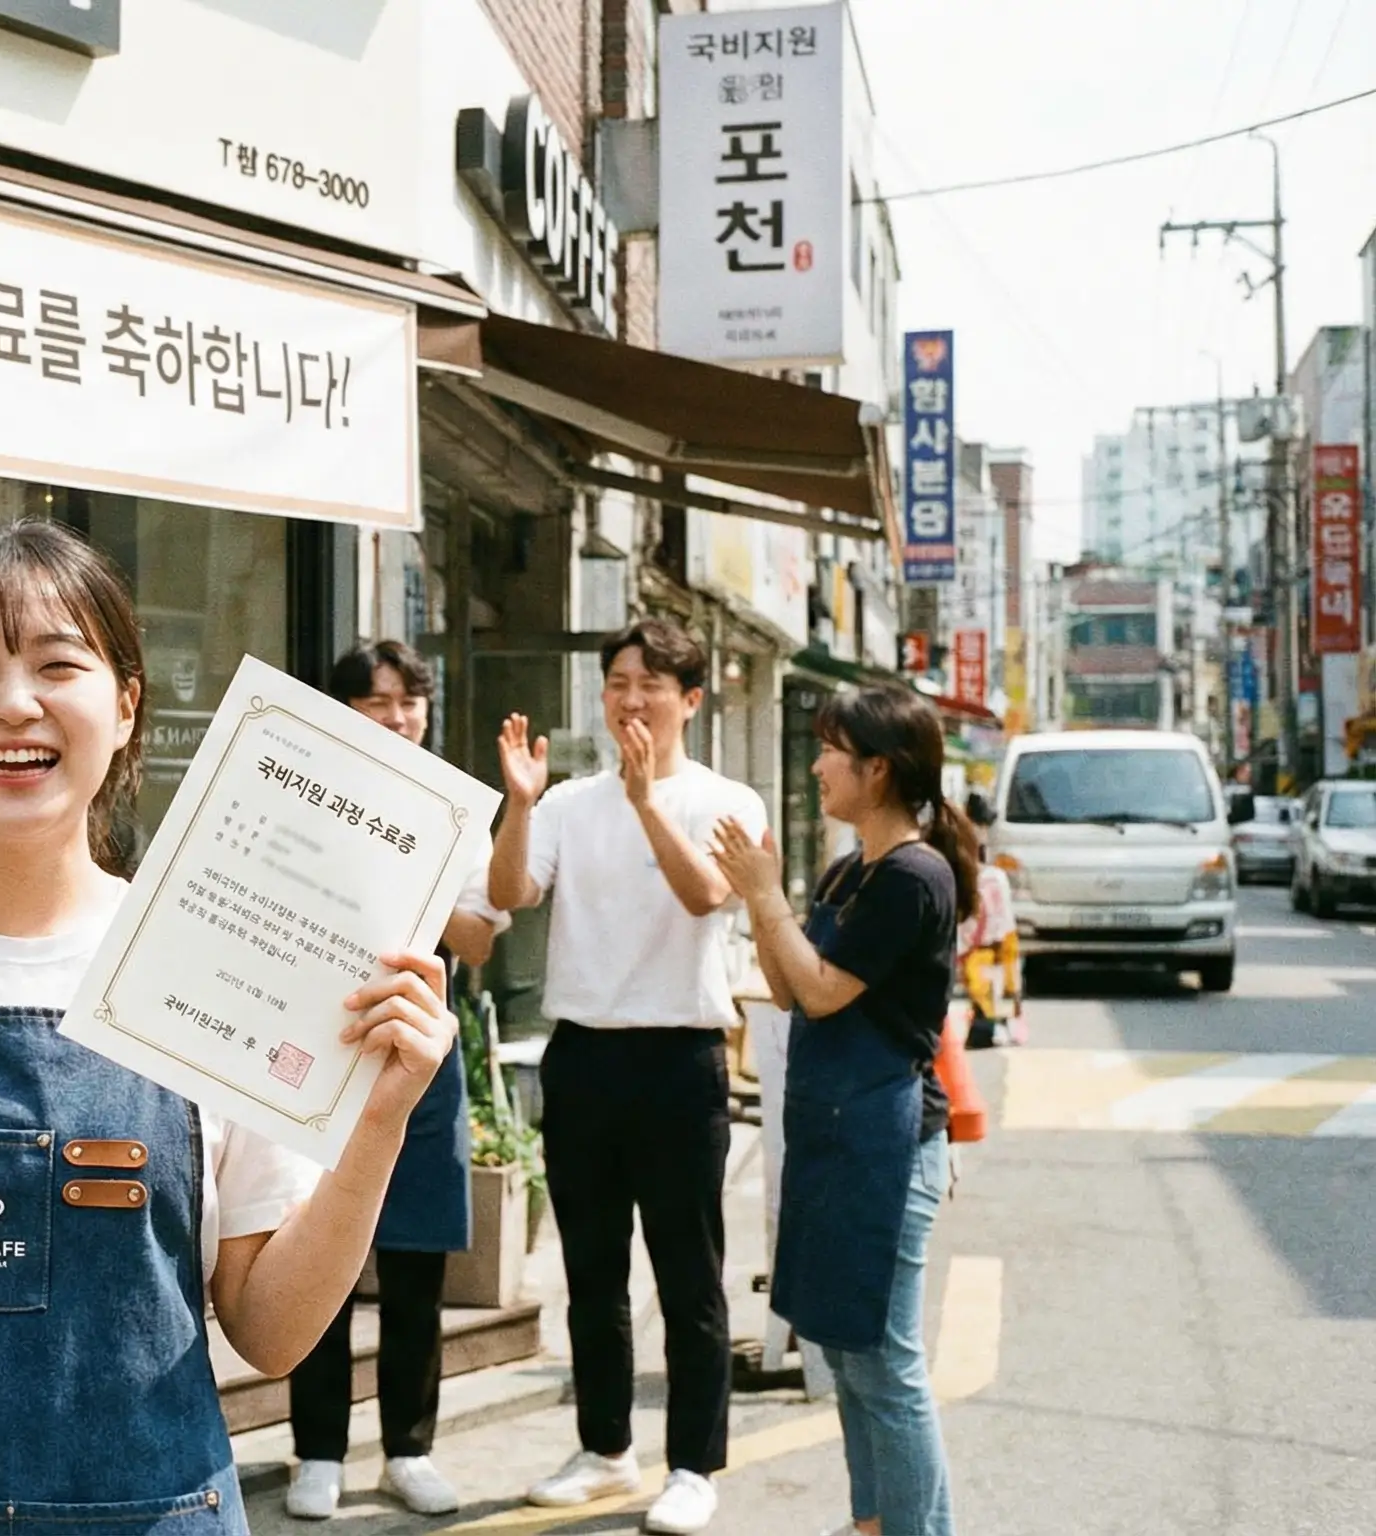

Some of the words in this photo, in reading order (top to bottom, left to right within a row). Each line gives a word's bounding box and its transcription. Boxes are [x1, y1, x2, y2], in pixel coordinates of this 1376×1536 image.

[686, 25, 818, 62] 국비지원
[265, 153, 369, 209] 678-3000
[525, 93, 619, 341] COFFEE
[715, 122, 788, 272] 포천
[102, 304, 353, 428] 축하합니다!
[257, 755, 327, 807] 국비지원
[326, 782, 367, 828] 과정
[365, 815, 417, 855] 수료증
